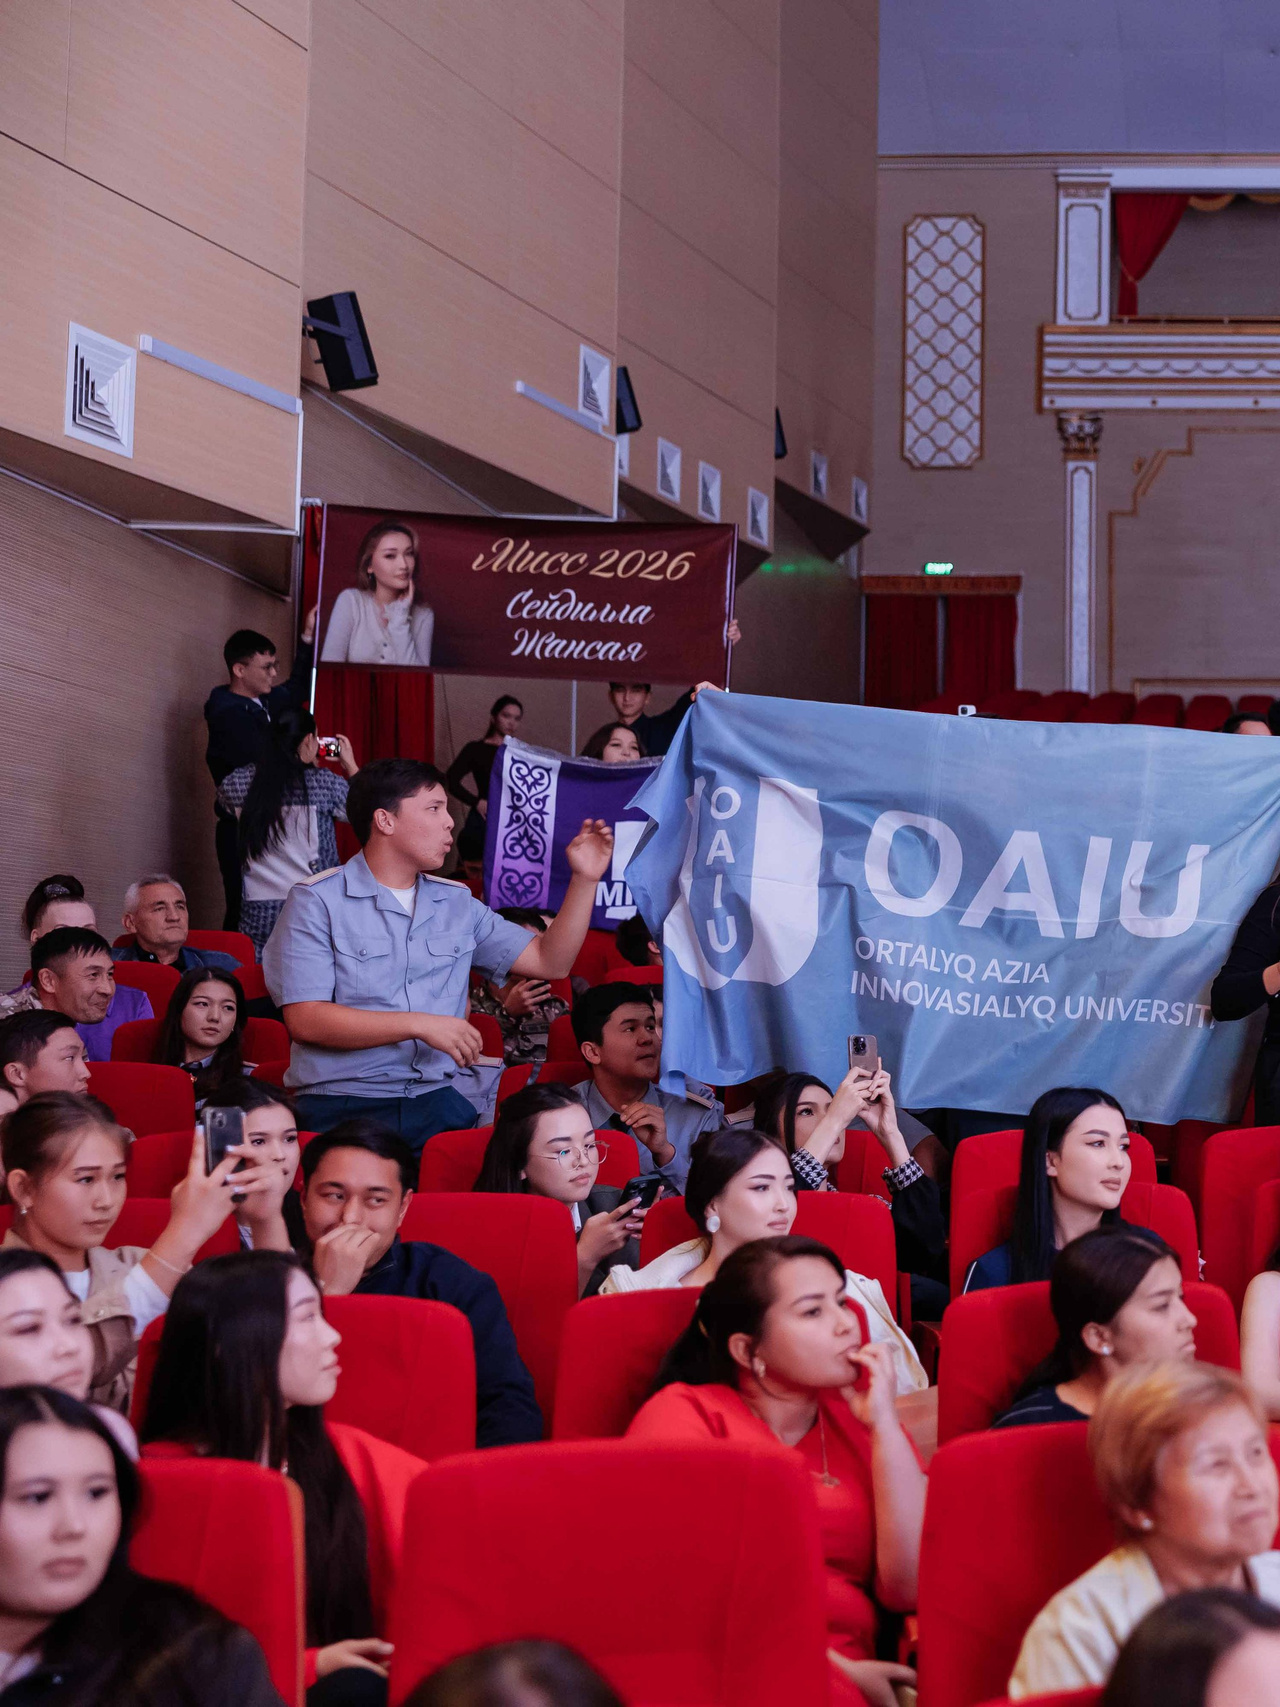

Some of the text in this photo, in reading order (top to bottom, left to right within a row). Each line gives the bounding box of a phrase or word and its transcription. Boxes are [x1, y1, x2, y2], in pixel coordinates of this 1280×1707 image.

[471, 537, 696, 582] Мисс 2026
[510, 627, 648, 663] Жансая
[706, 786, 741, 953] OAIU
[865, 810, 1210, 939] OAIU
[855, 936, 1050, 984] ORTALYQ AZIA
[850, 970, 1215, 1029] INNOVASIALYQ UNIVERSIT
